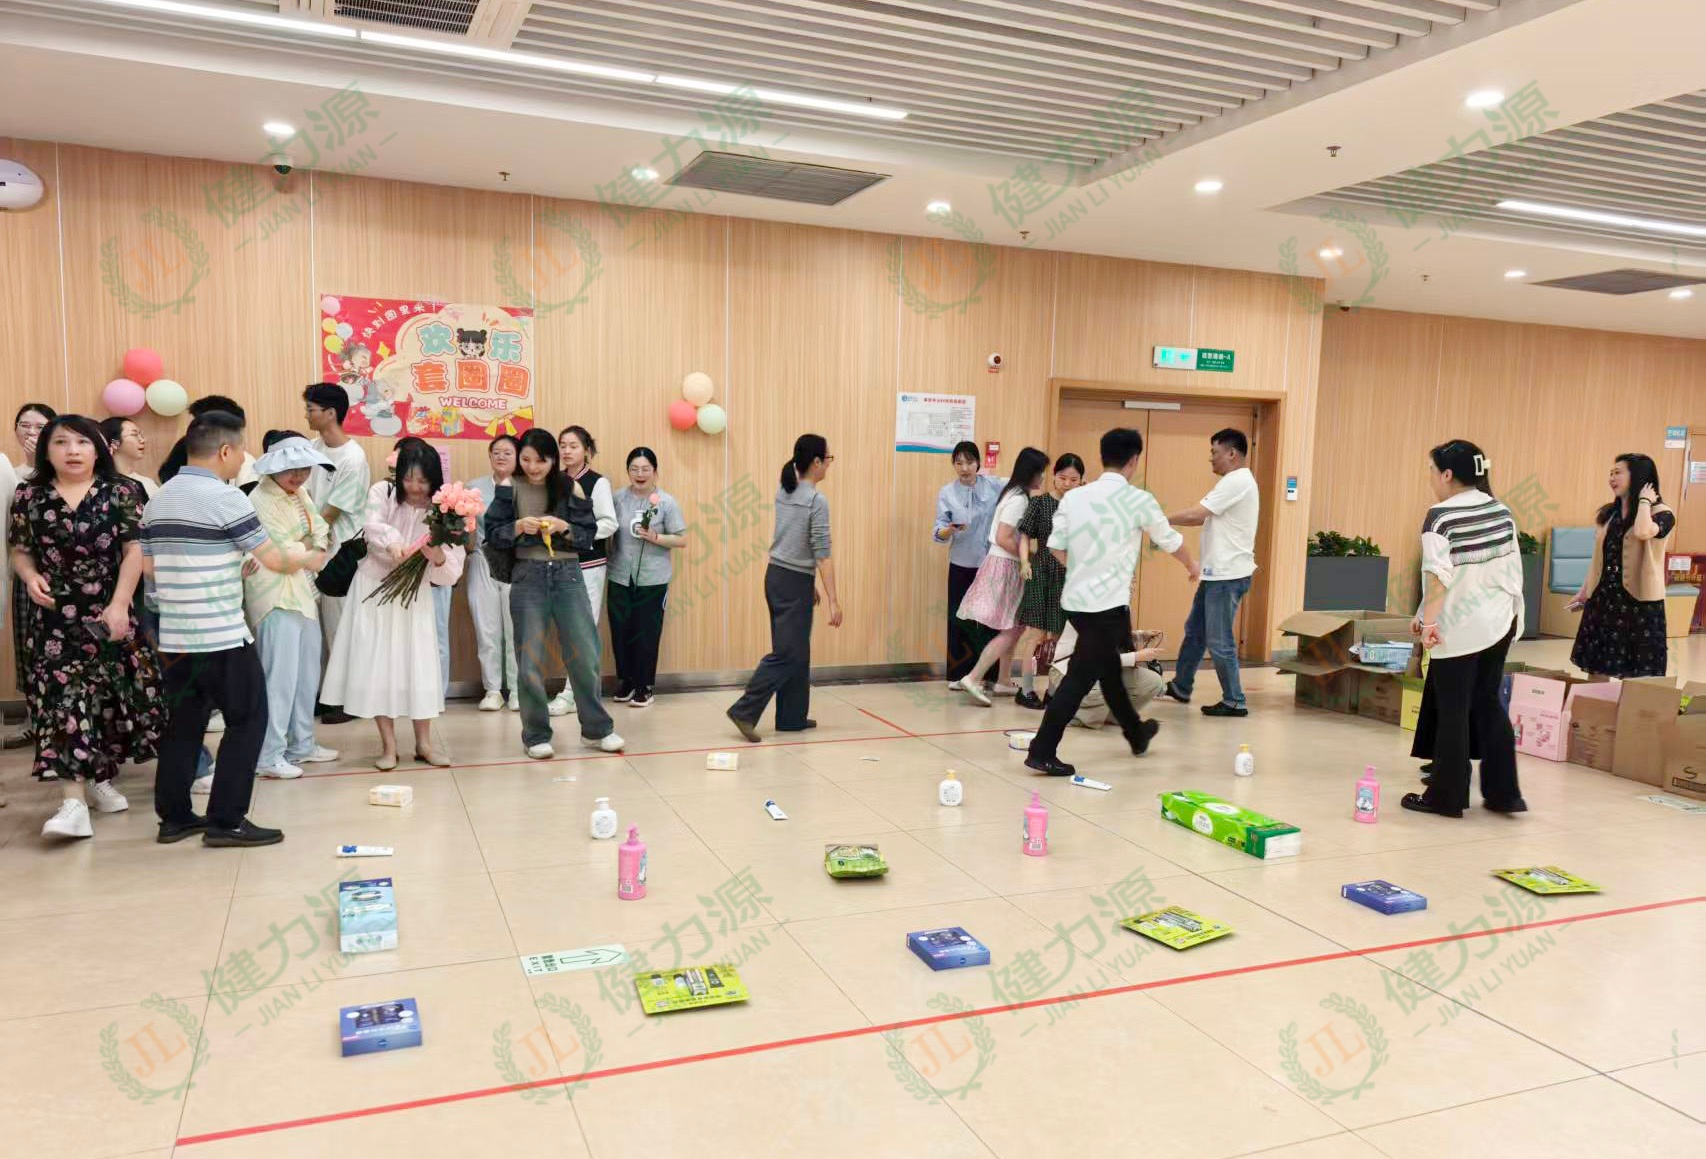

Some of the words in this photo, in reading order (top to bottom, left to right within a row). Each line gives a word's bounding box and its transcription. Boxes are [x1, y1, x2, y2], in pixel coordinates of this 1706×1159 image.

[412, 360, 530, 398] 套圈圈
[440, 396, 507, 410] WELCOME
[529, 956, 543, 972] EXIT
